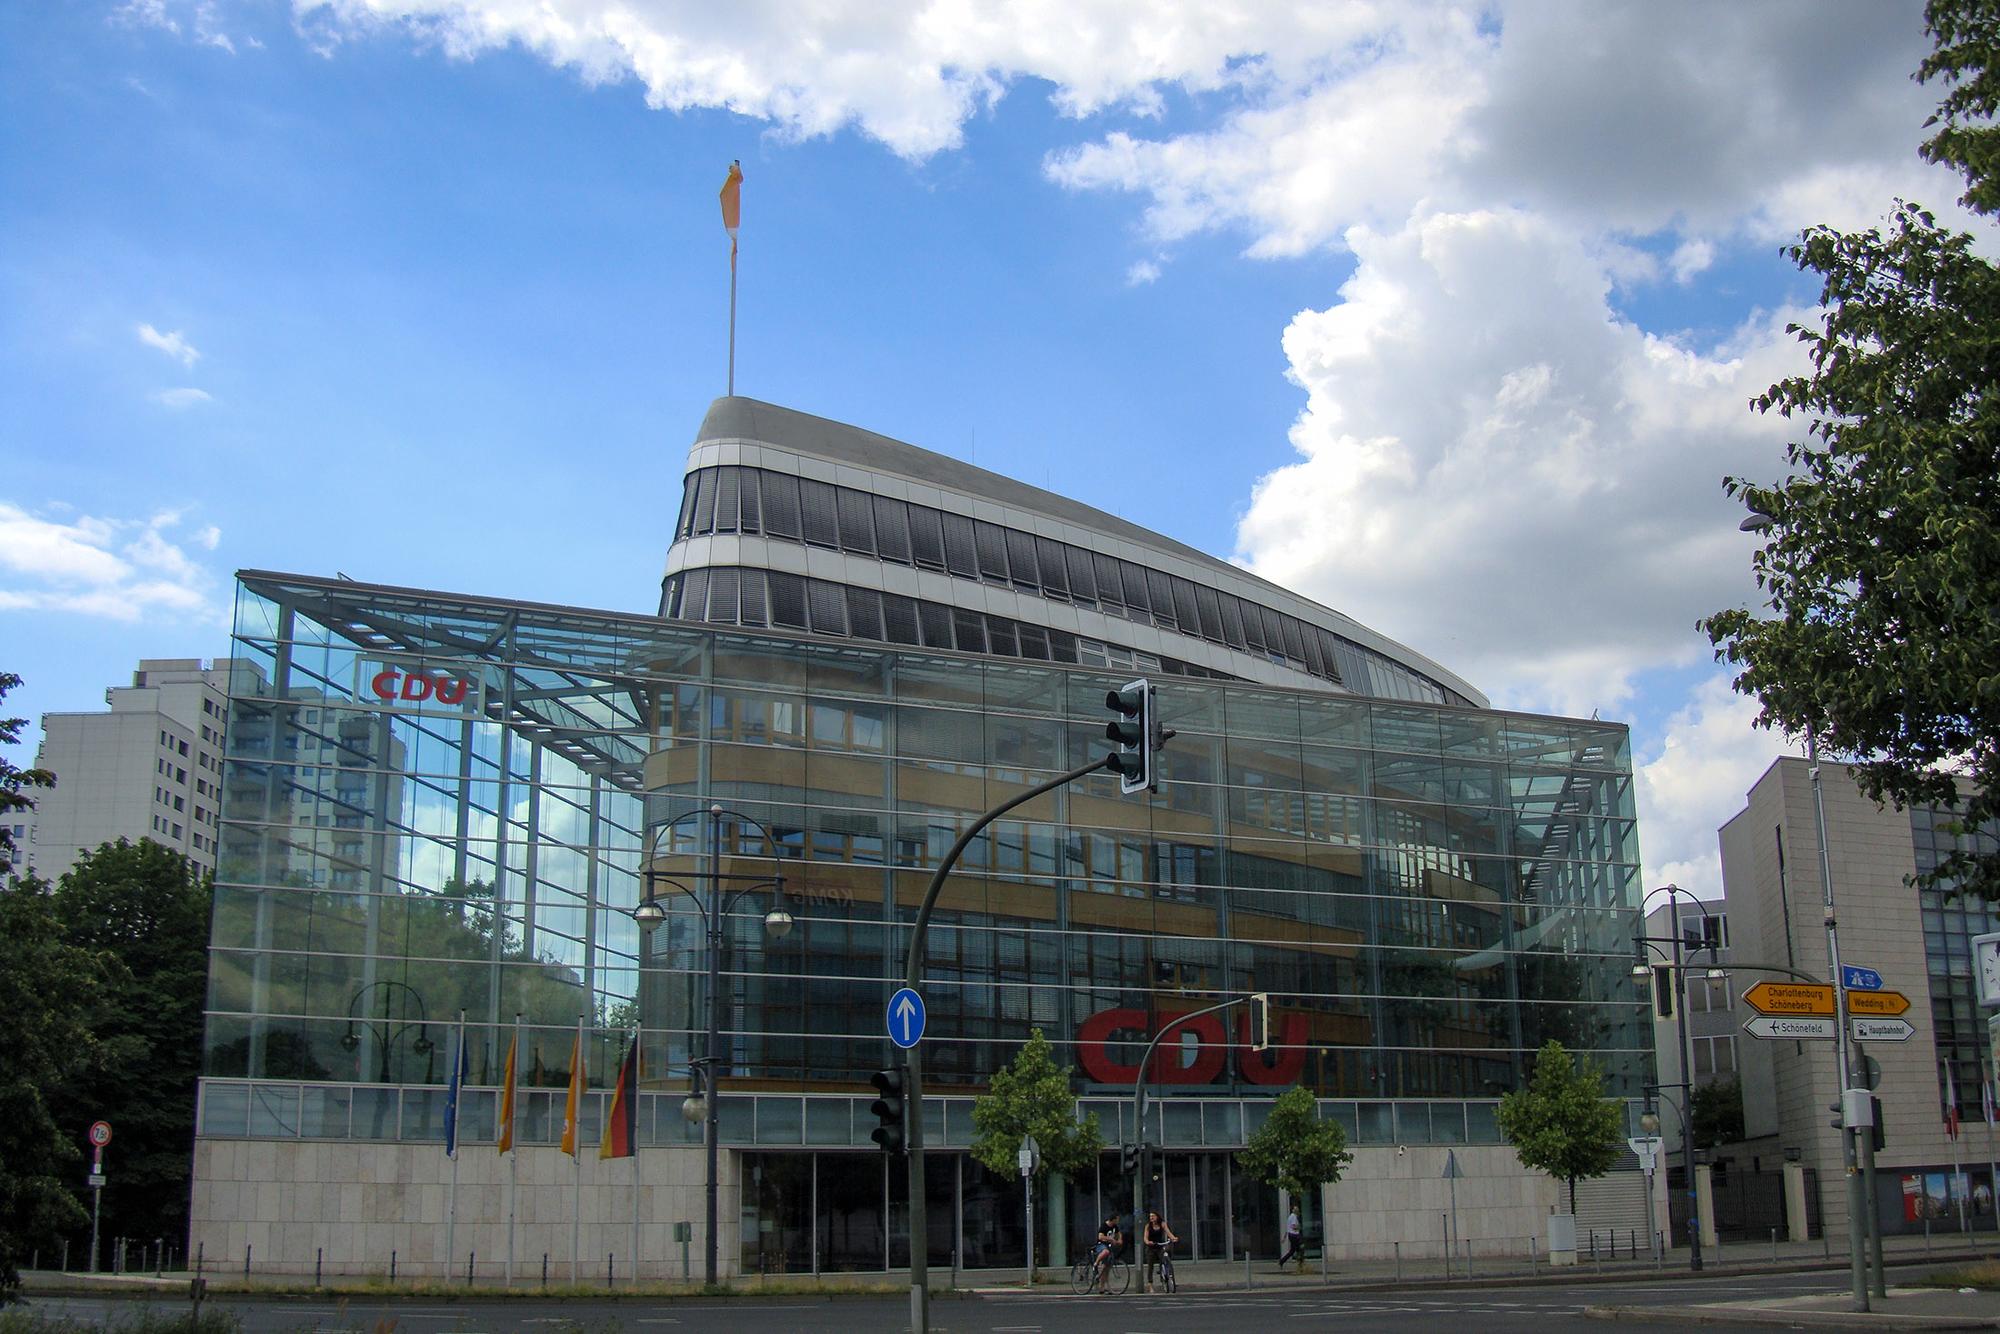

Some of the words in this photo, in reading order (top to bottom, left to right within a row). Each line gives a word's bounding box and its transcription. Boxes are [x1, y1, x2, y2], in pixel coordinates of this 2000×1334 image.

[372, 671, 467, 705] CDU
[1768, 987, 1823, 1001] Charlottenburg
[1769, 999, 1813, 1011] Schöneberg
[1854, 999, 1884, 1010] Wedding
[1781, 1022, 1823, 1033] Schönefeld
[1868, 1025, 1905, 1037] Hauptbahnhof
[1077, 1007, 1309, 1085] CDU
